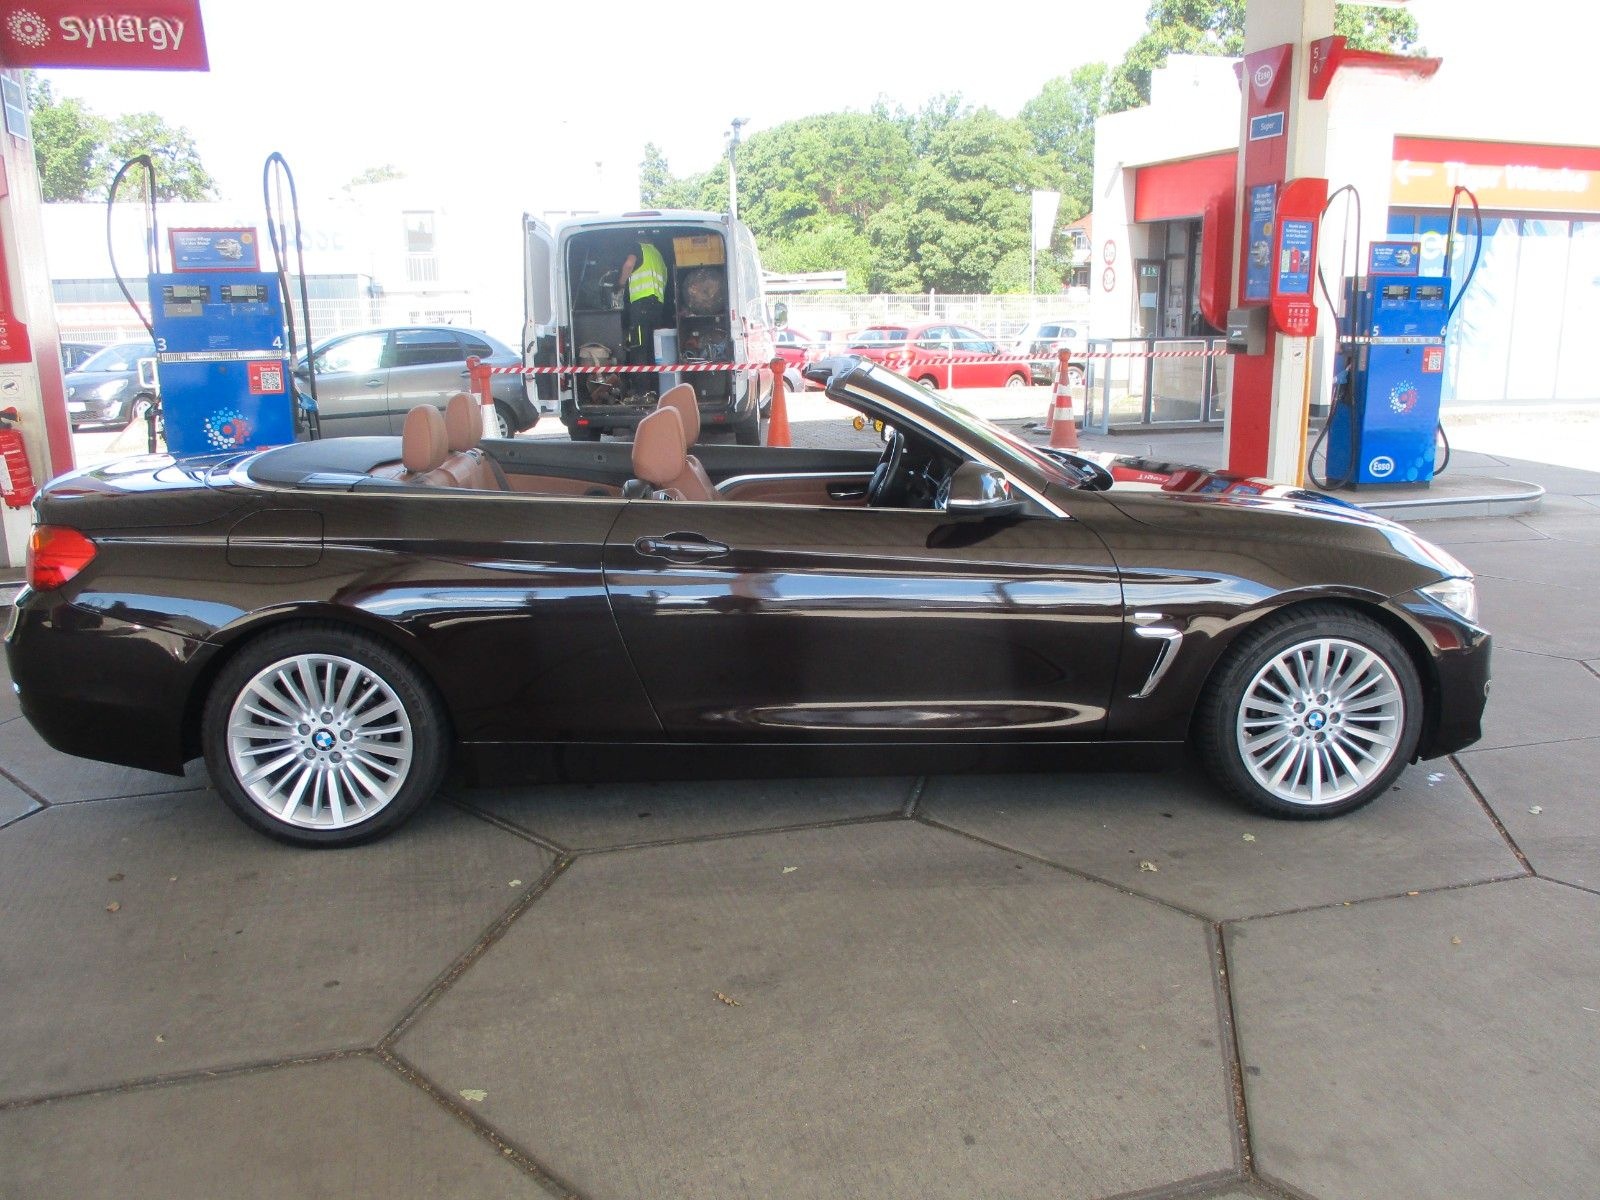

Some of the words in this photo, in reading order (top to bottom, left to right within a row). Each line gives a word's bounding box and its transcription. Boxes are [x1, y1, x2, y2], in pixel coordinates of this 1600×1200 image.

[1313, 47, 1319, 59] 5
[1312, 61, 1318, 74] 6
[1260, 122, 1275, 132] Super
[1372, 325, 1379, 337] 5
[1440, 325, 1447, 336] 6
[157, 338, 167, 351] 3
[272, 336, 283, 348] 4
